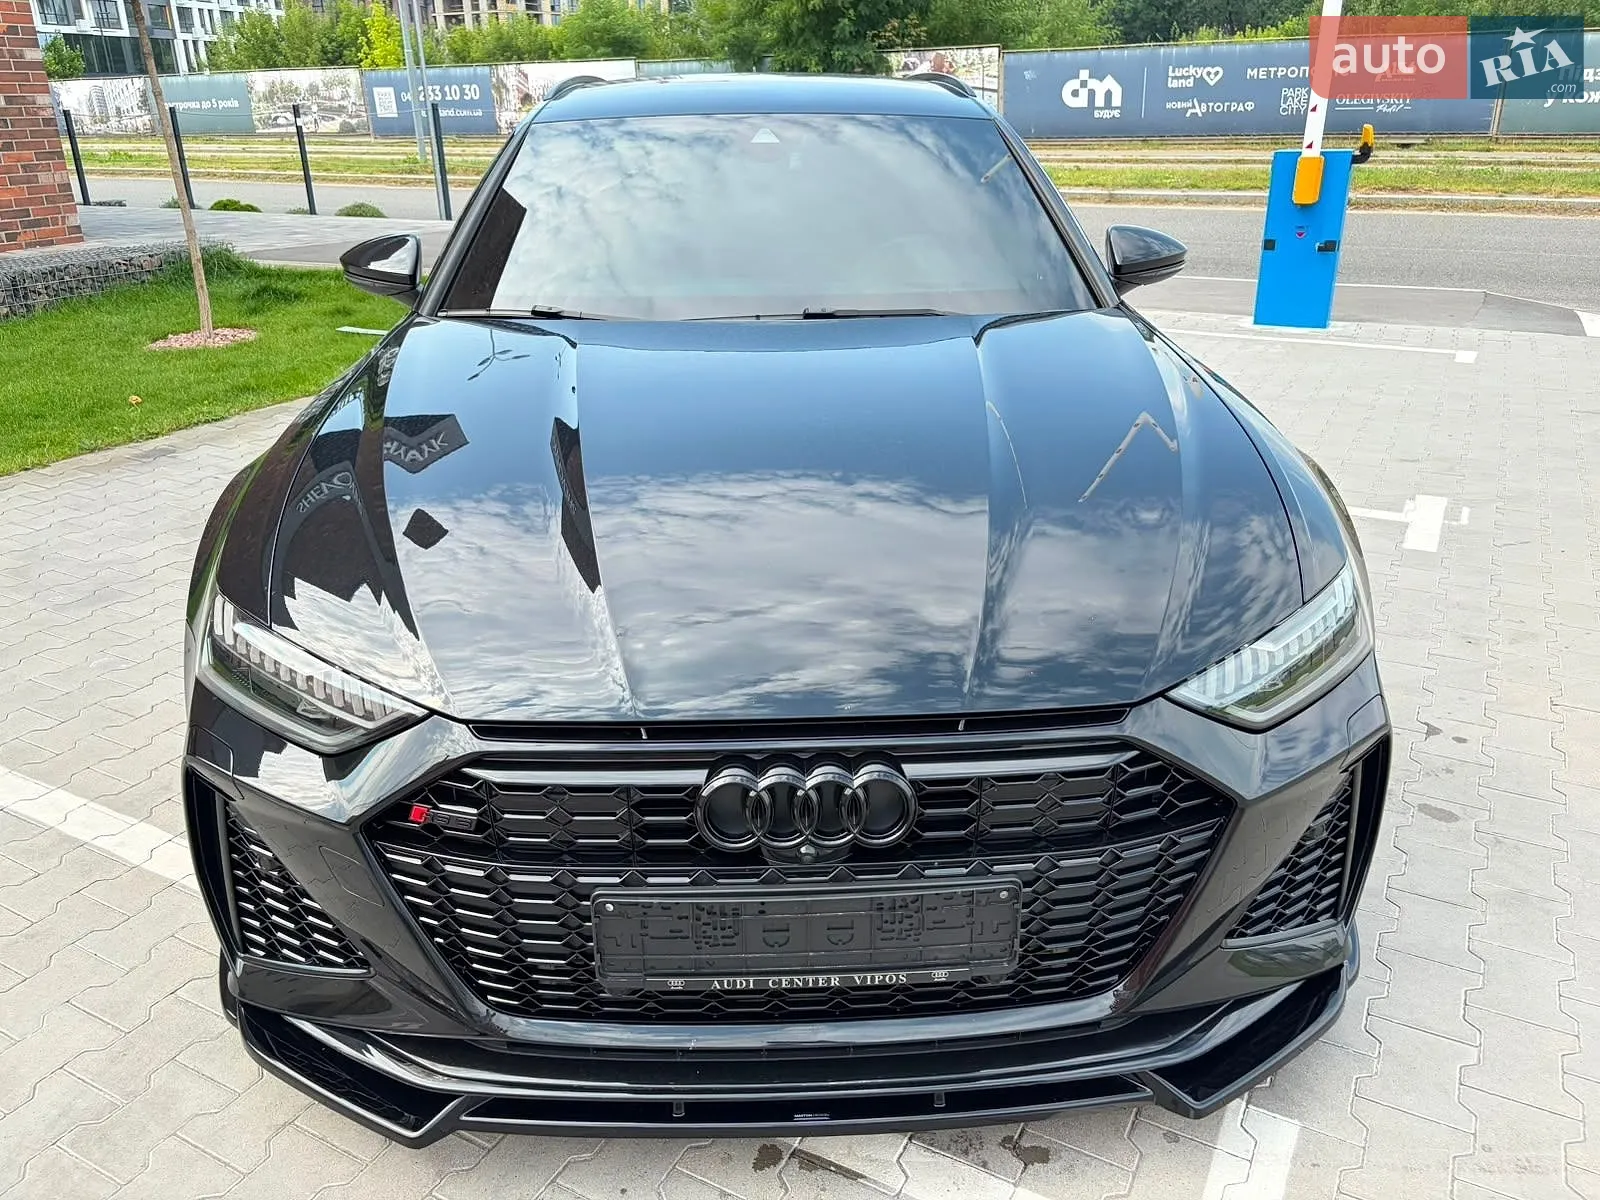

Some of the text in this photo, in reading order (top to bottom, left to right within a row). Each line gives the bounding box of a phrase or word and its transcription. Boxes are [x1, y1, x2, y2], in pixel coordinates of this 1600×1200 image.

[1168, 65, 1203, 79] Lucky
[1167, 76, 1194, 88] land
[444, 84, 460, 100] 10
[462, 84, 480, 100] 30
[1282, 87, 1309, 97] PARK
[201, 100, 212, 110] до
[219, 97, 240, 110] років
[1281, 96, 1308, 106] LAKE
[1280, 105, 1307, 115] CITY
[711, 972, 908, 990] AUDI CENTER VIPOS
